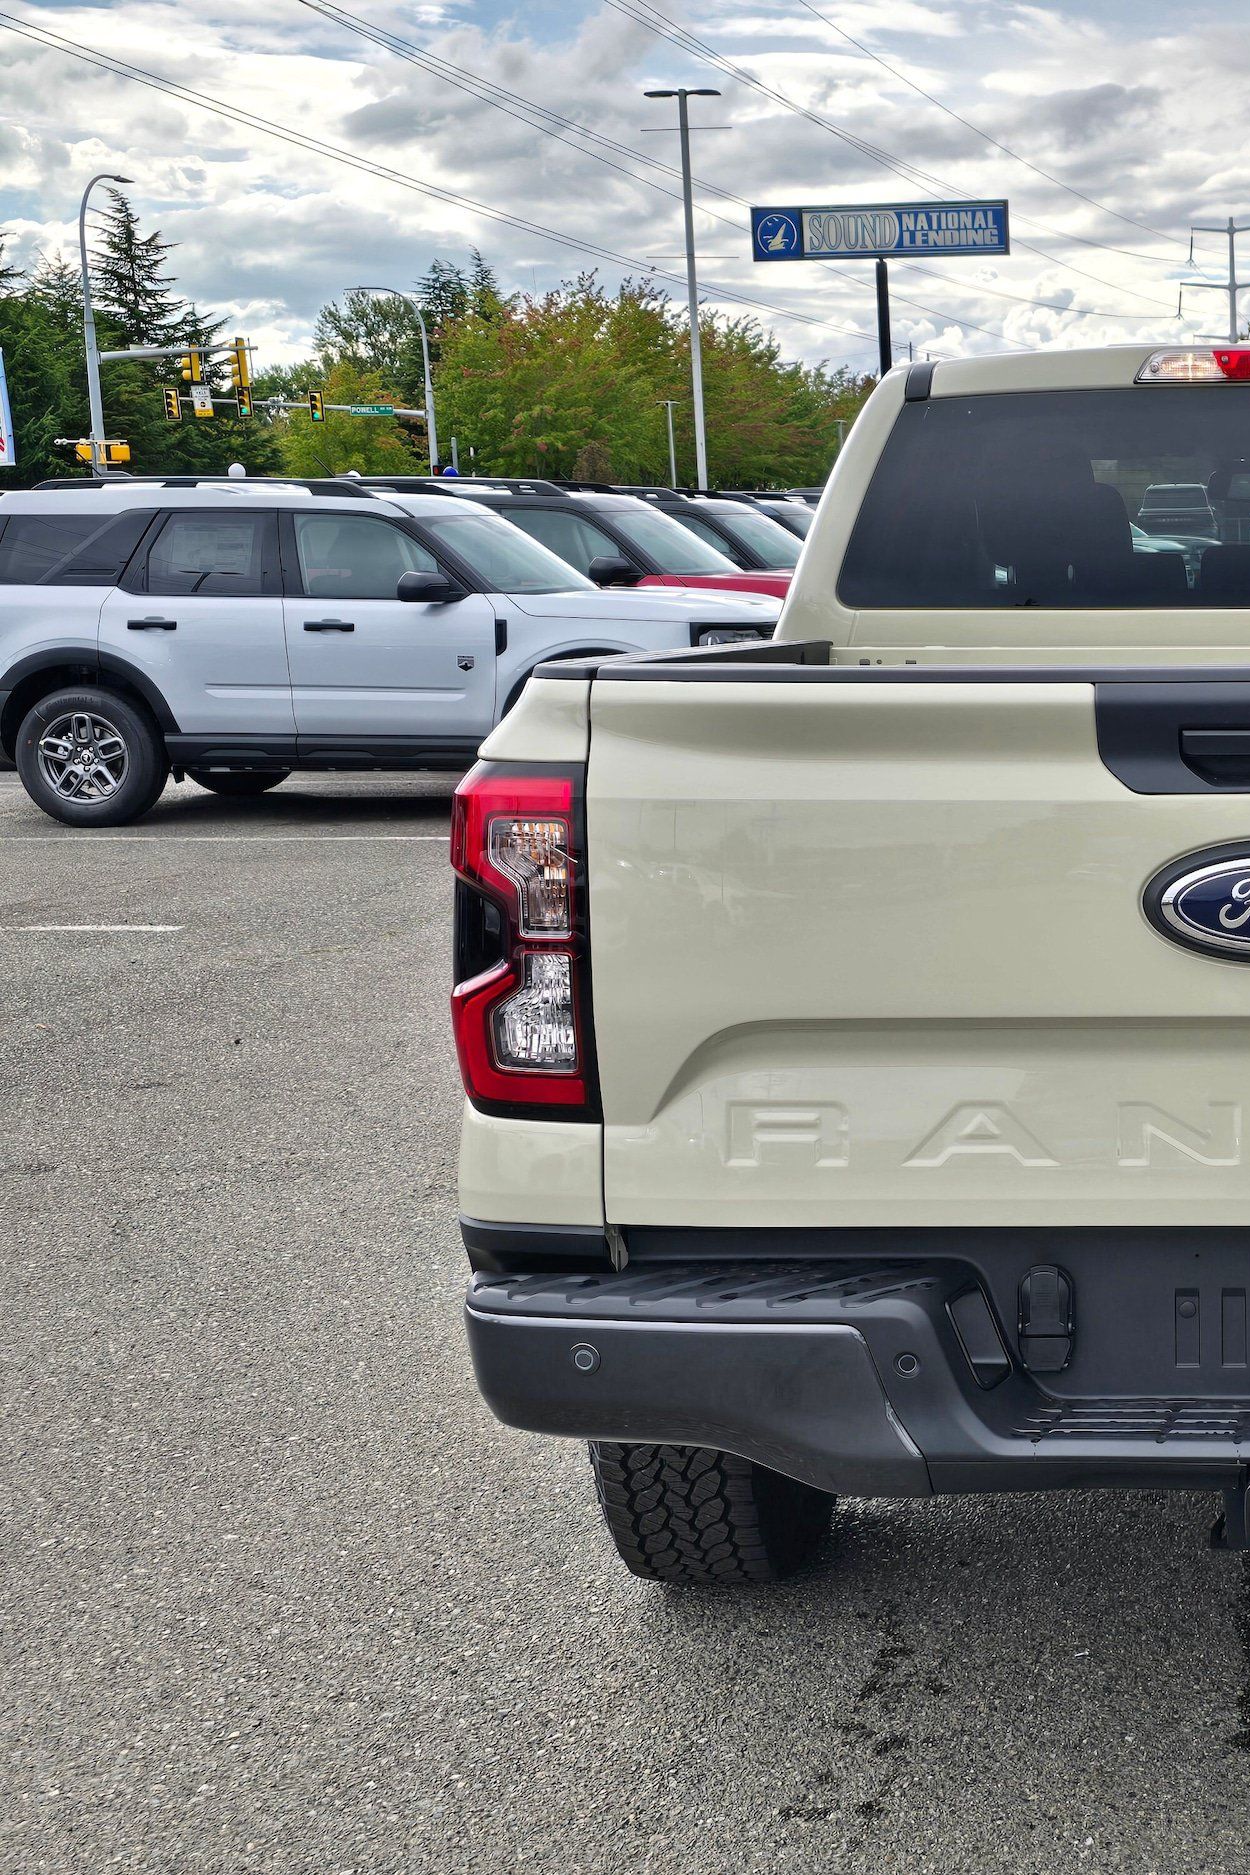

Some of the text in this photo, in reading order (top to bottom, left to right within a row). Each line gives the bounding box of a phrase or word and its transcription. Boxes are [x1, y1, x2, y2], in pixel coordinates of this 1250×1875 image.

[901, 210, 997, 230] NATIONAL
[808, 213, 897, 251] SOUND
[903, 228, 999, 247] LENDING
